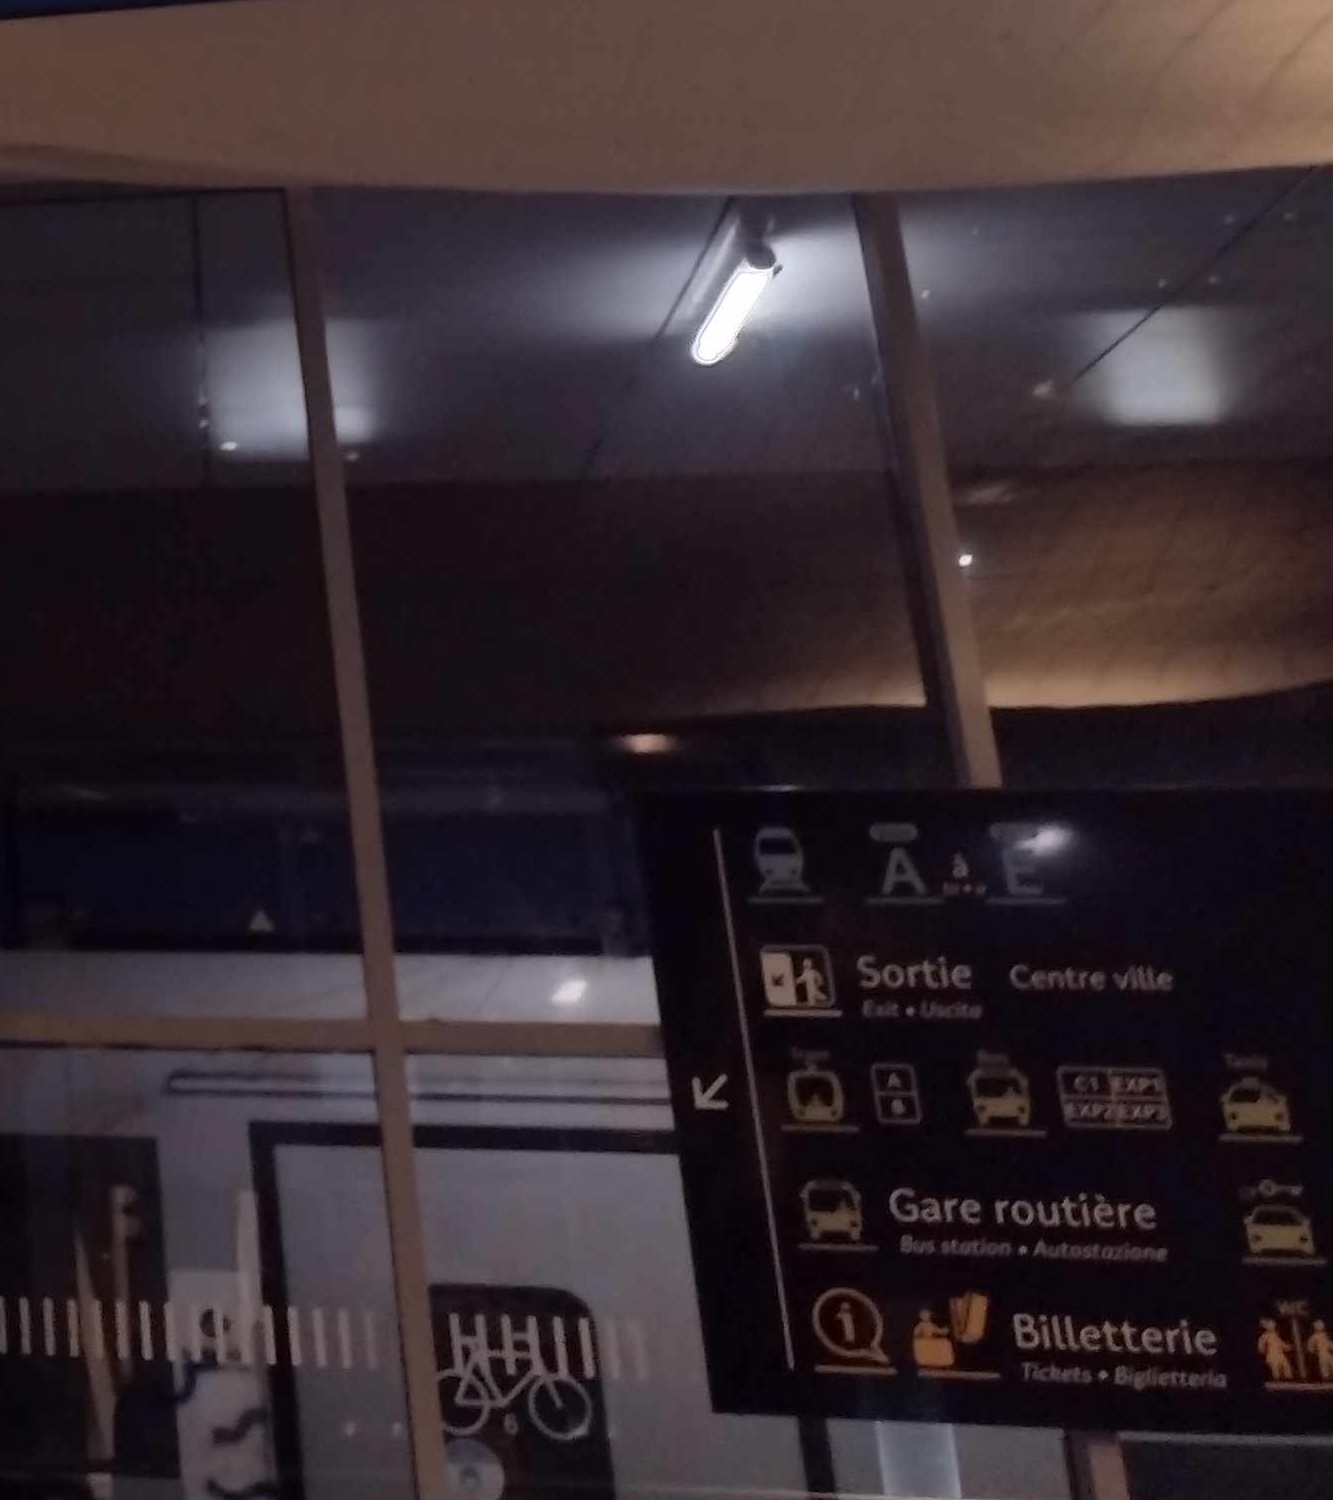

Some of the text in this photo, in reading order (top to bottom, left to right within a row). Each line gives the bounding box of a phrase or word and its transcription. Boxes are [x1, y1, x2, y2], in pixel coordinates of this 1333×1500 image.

[882, 845, 1043, 895] A E
[857, 954, 1173, 991] Sortie Centre ville
[889, 1187, 1157, 1230] Gare routière
[900, 1236, 935, 1254] Bus
[1012, 1313, 1217, 1357] Billetterie
